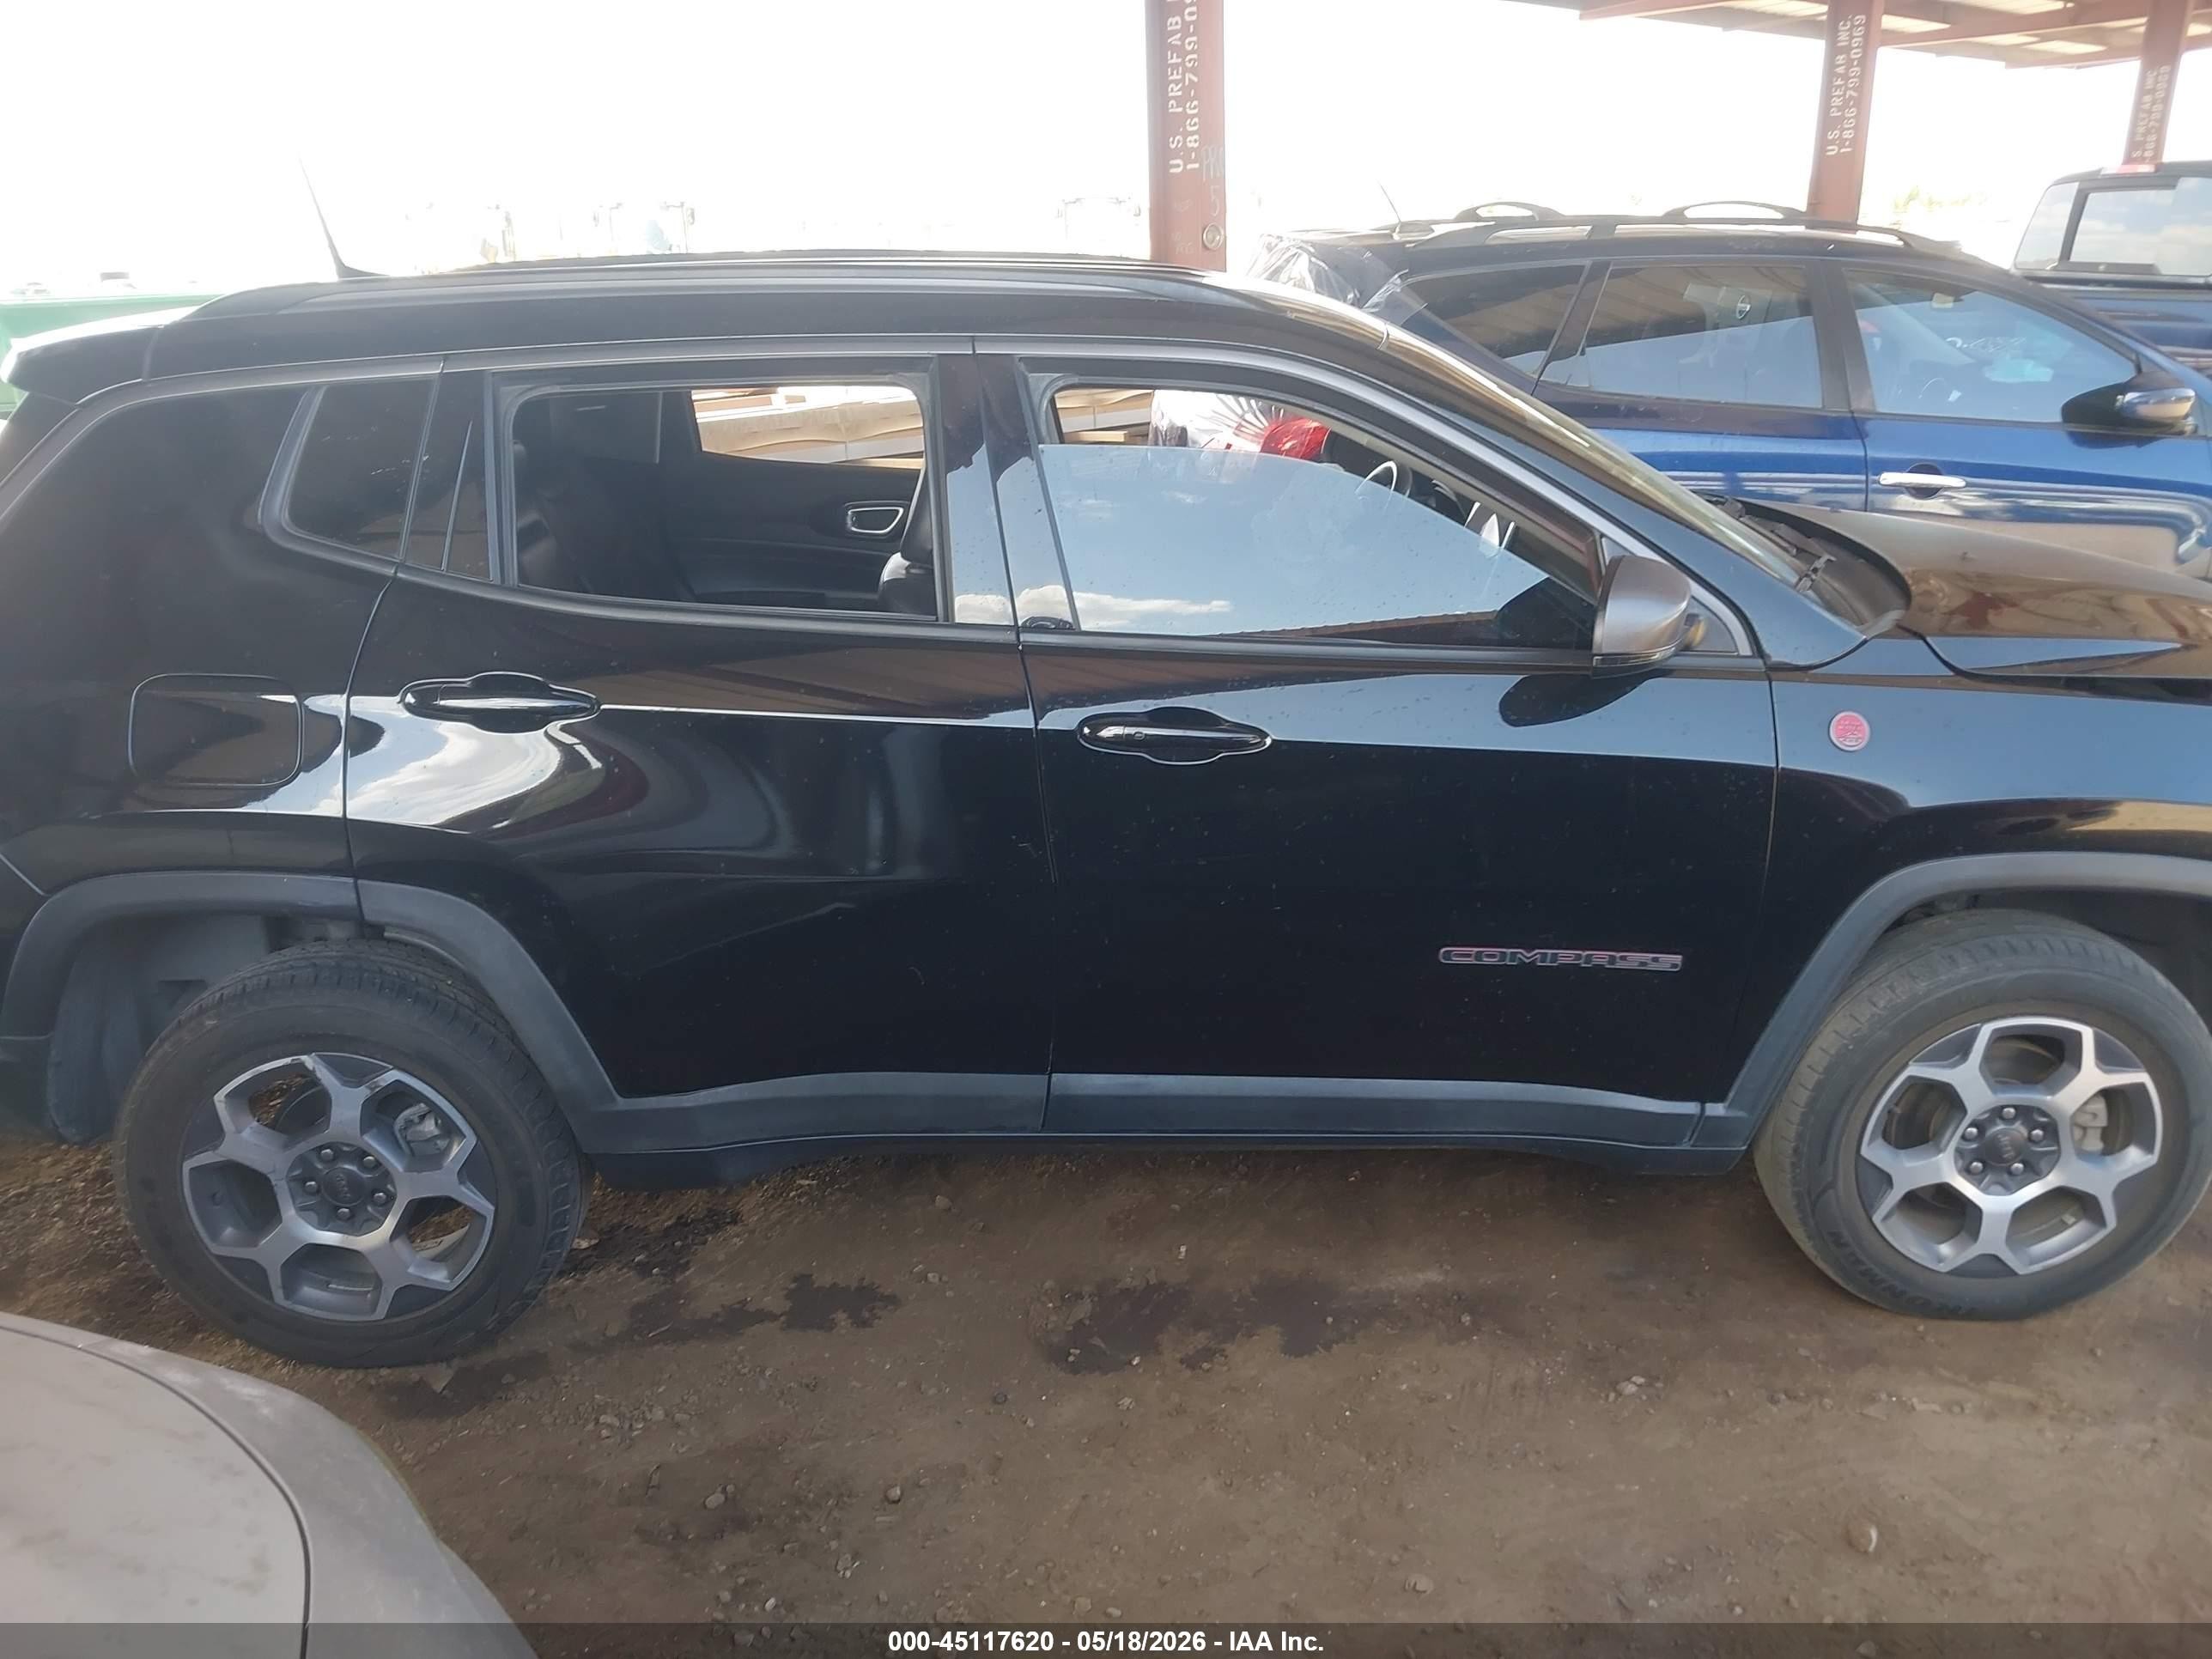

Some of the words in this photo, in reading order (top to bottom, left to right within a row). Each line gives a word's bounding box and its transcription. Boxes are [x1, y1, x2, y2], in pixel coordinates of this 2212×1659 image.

[1837, 15, 1853, 46] INC.
[1168, 15, 1183, 113] PREFAB
[1829, 54, 1847, 117] PREFAB
[1839, 15, 1867, 153] 1-866-799-0969
[1168, 127, 1183, 173] U.S.
[1826, 125, 1841, 156] U.S.
[1438, 947, 1683, 972] COMPASS
